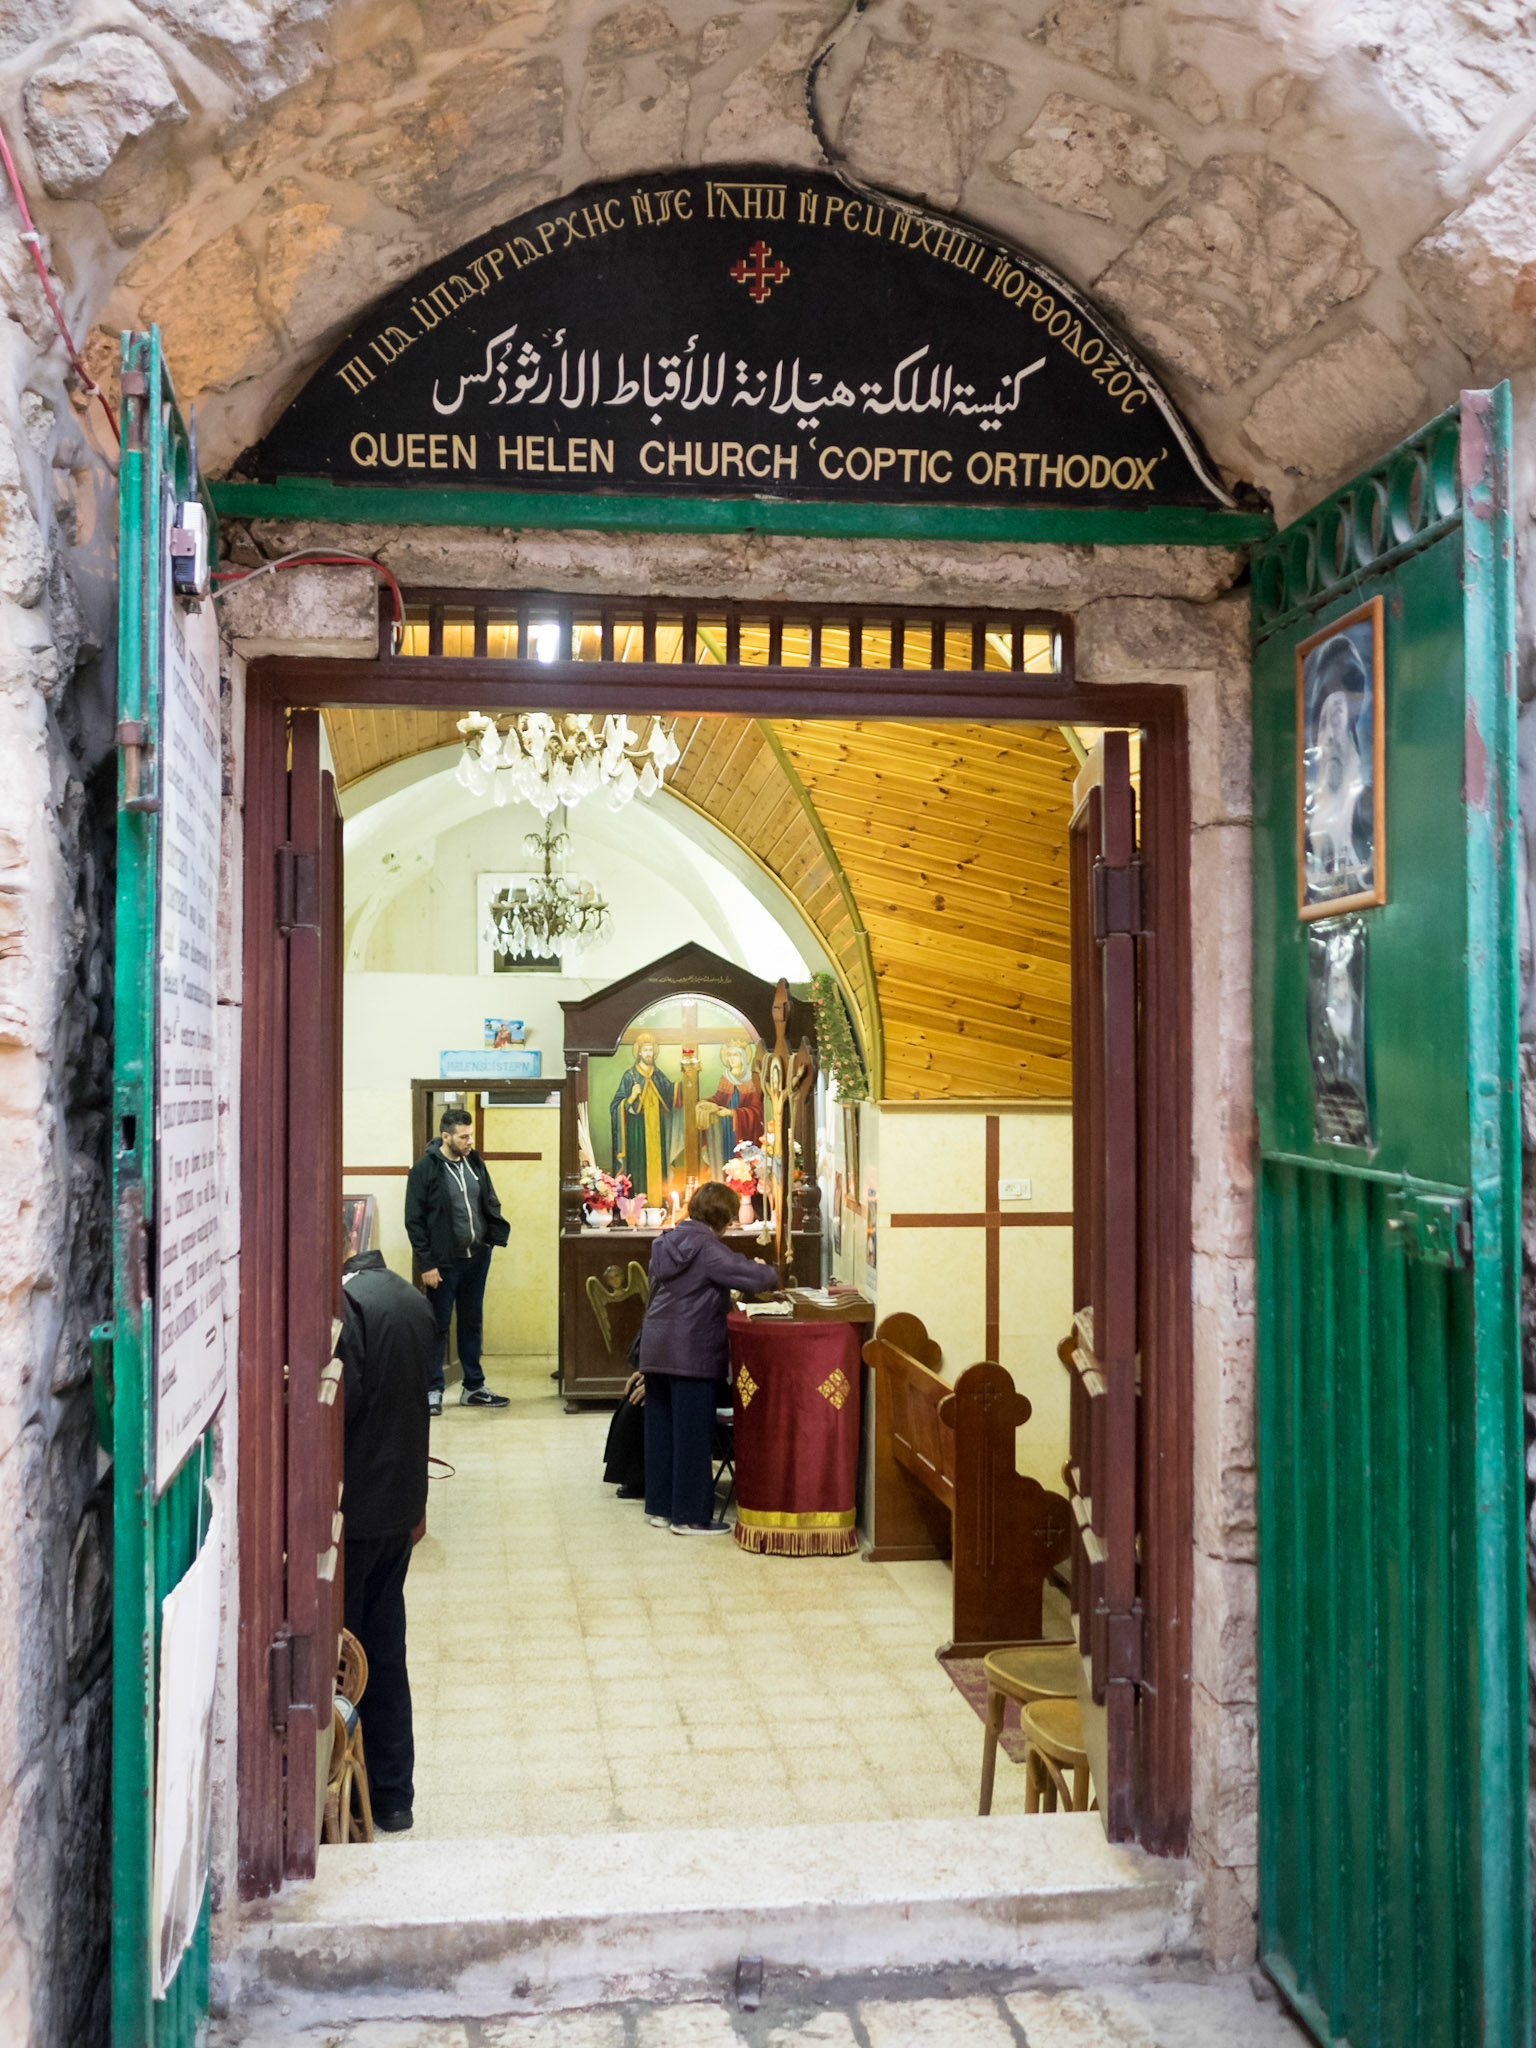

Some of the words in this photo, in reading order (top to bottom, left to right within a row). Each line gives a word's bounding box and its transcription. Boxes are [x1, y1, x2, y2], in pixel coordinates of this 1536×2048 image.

[602, 332, 726, 426] للأقباط
[862, 343, 953, 415] الملكة
[949, 355, 1047, 432] كنيسة
[349, 431, 477, 470] QUEEN
[498, 434, 614, 474] HELEN
[639, 439, 797, 480] CHURCH
